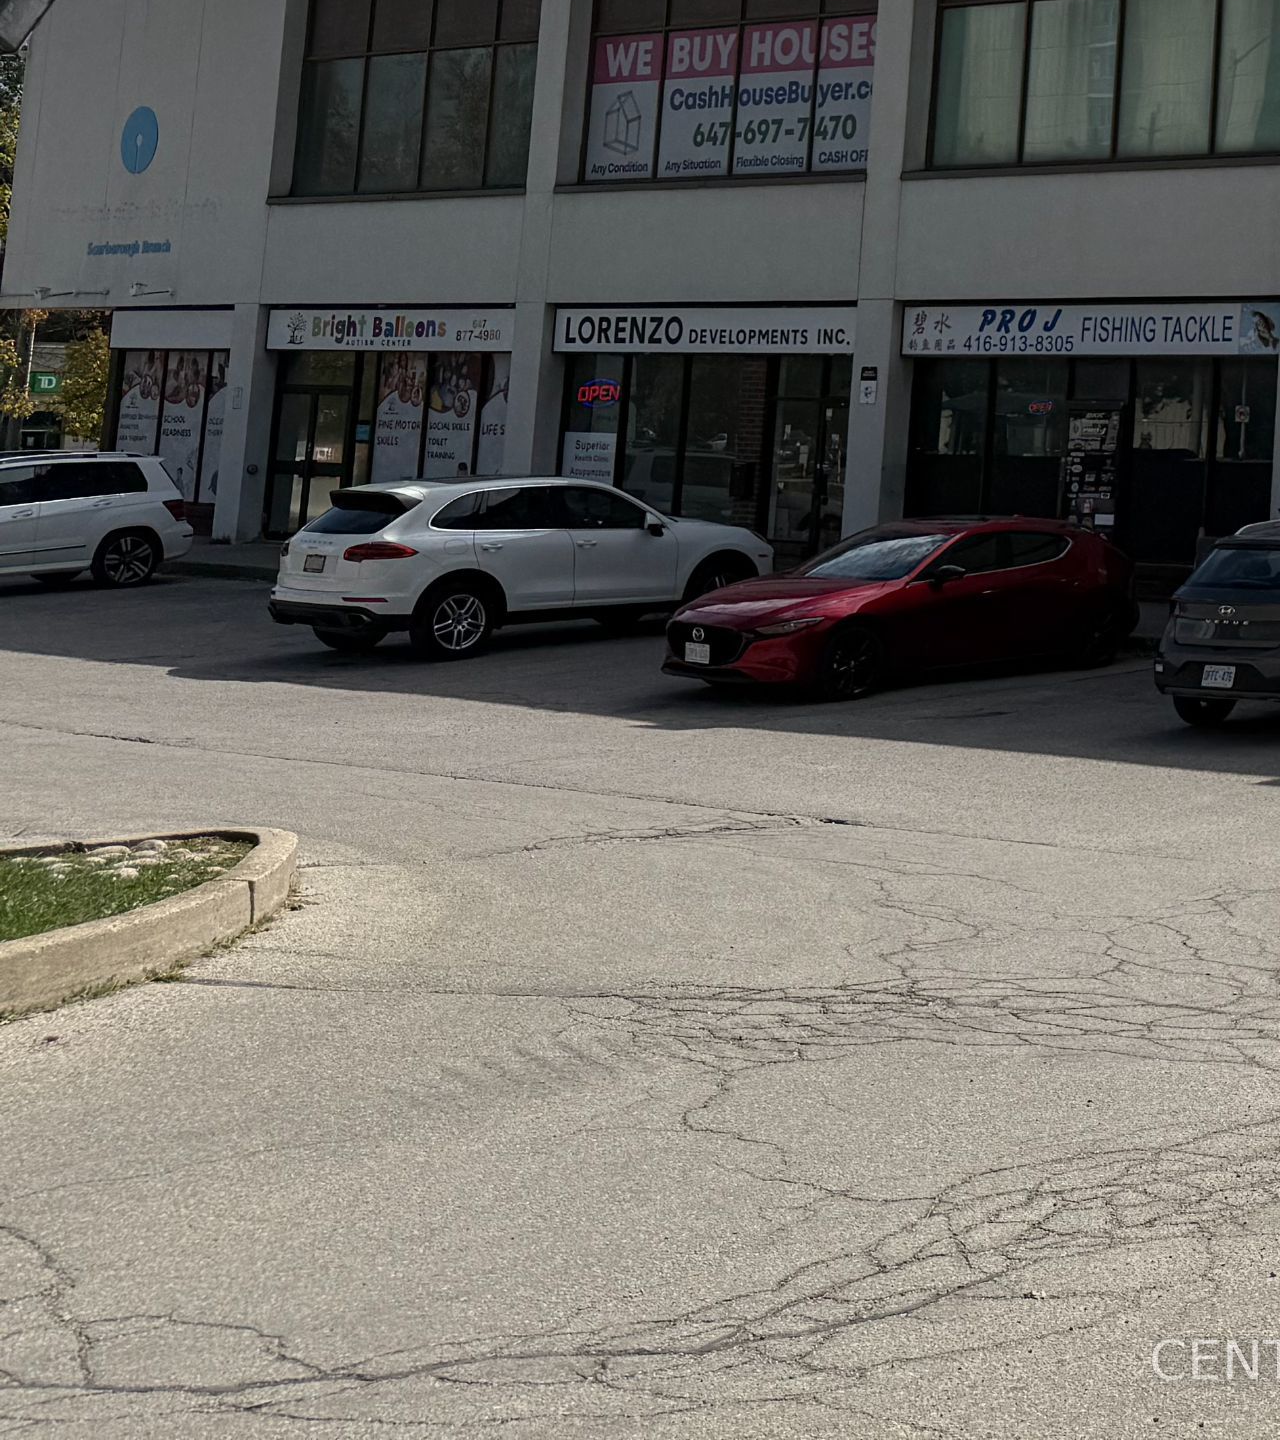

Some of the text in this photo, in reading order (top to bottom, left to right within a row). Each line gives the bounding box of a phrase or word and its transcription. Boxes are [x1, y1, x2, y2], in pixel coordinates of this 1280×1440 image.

[606, 40, 653, 77] WE
[671, 33, 737, 73] BUY
[670, 79, 873, 110] CashHouseBuyer.c
[693, 113, 857, 147] 647-697-7470
[736, 154, 804, 167] Flexible Closing
[818, 150, 848, 163] CASH
[591, 161, 649, 175] Any Condition
[665, 159, 721, 173] Any Situation
[311, 315, 446, 344] Bright Balloons
[565, 316, 850, 345] LORENZO DEVELOPMENTS INC.
[1081, 316, 1233, 343] FISHING TACKLE
[963, 335, 1074, 352] 416-913-8305
[38, 376, 57, 389] TD
[577, 384, 621, 402] OPEN
